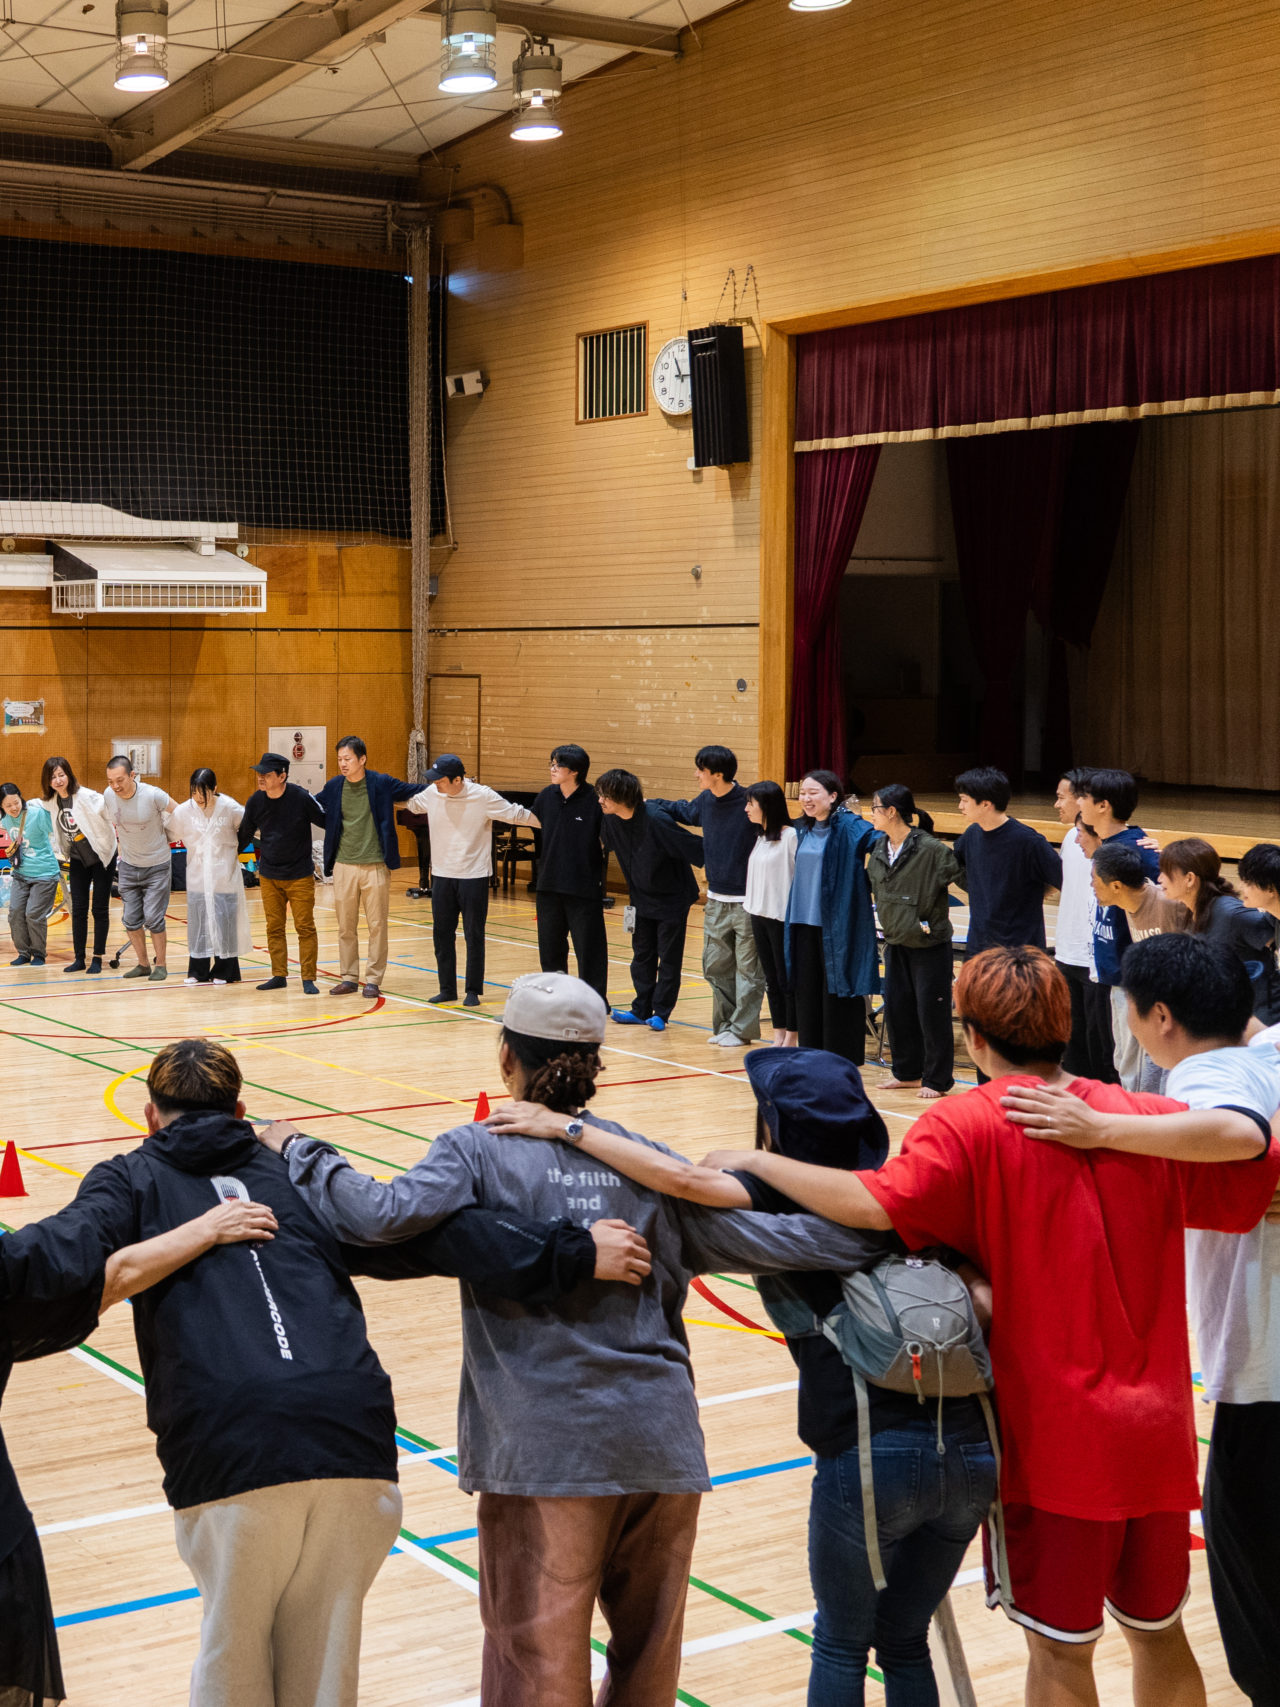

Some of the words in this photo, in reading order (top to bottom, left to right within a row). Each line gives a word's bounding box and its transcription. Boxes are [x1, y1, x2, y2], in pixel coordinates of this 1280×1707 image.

[677, 344, 686, 352] 12
[667, 351, 675, 359] 11
[661, 362, 669, 370] 10
[658, 375, 665, 383] 9
[661, 387, 667, 395] 8
[668, 397, 675, 405] 7
[678, 400, 685, 408] 6
[547, 1168, 574, 1186] the
[579, 1171, 621, 1188] filth
[567, 1195, 602, 1210] and
